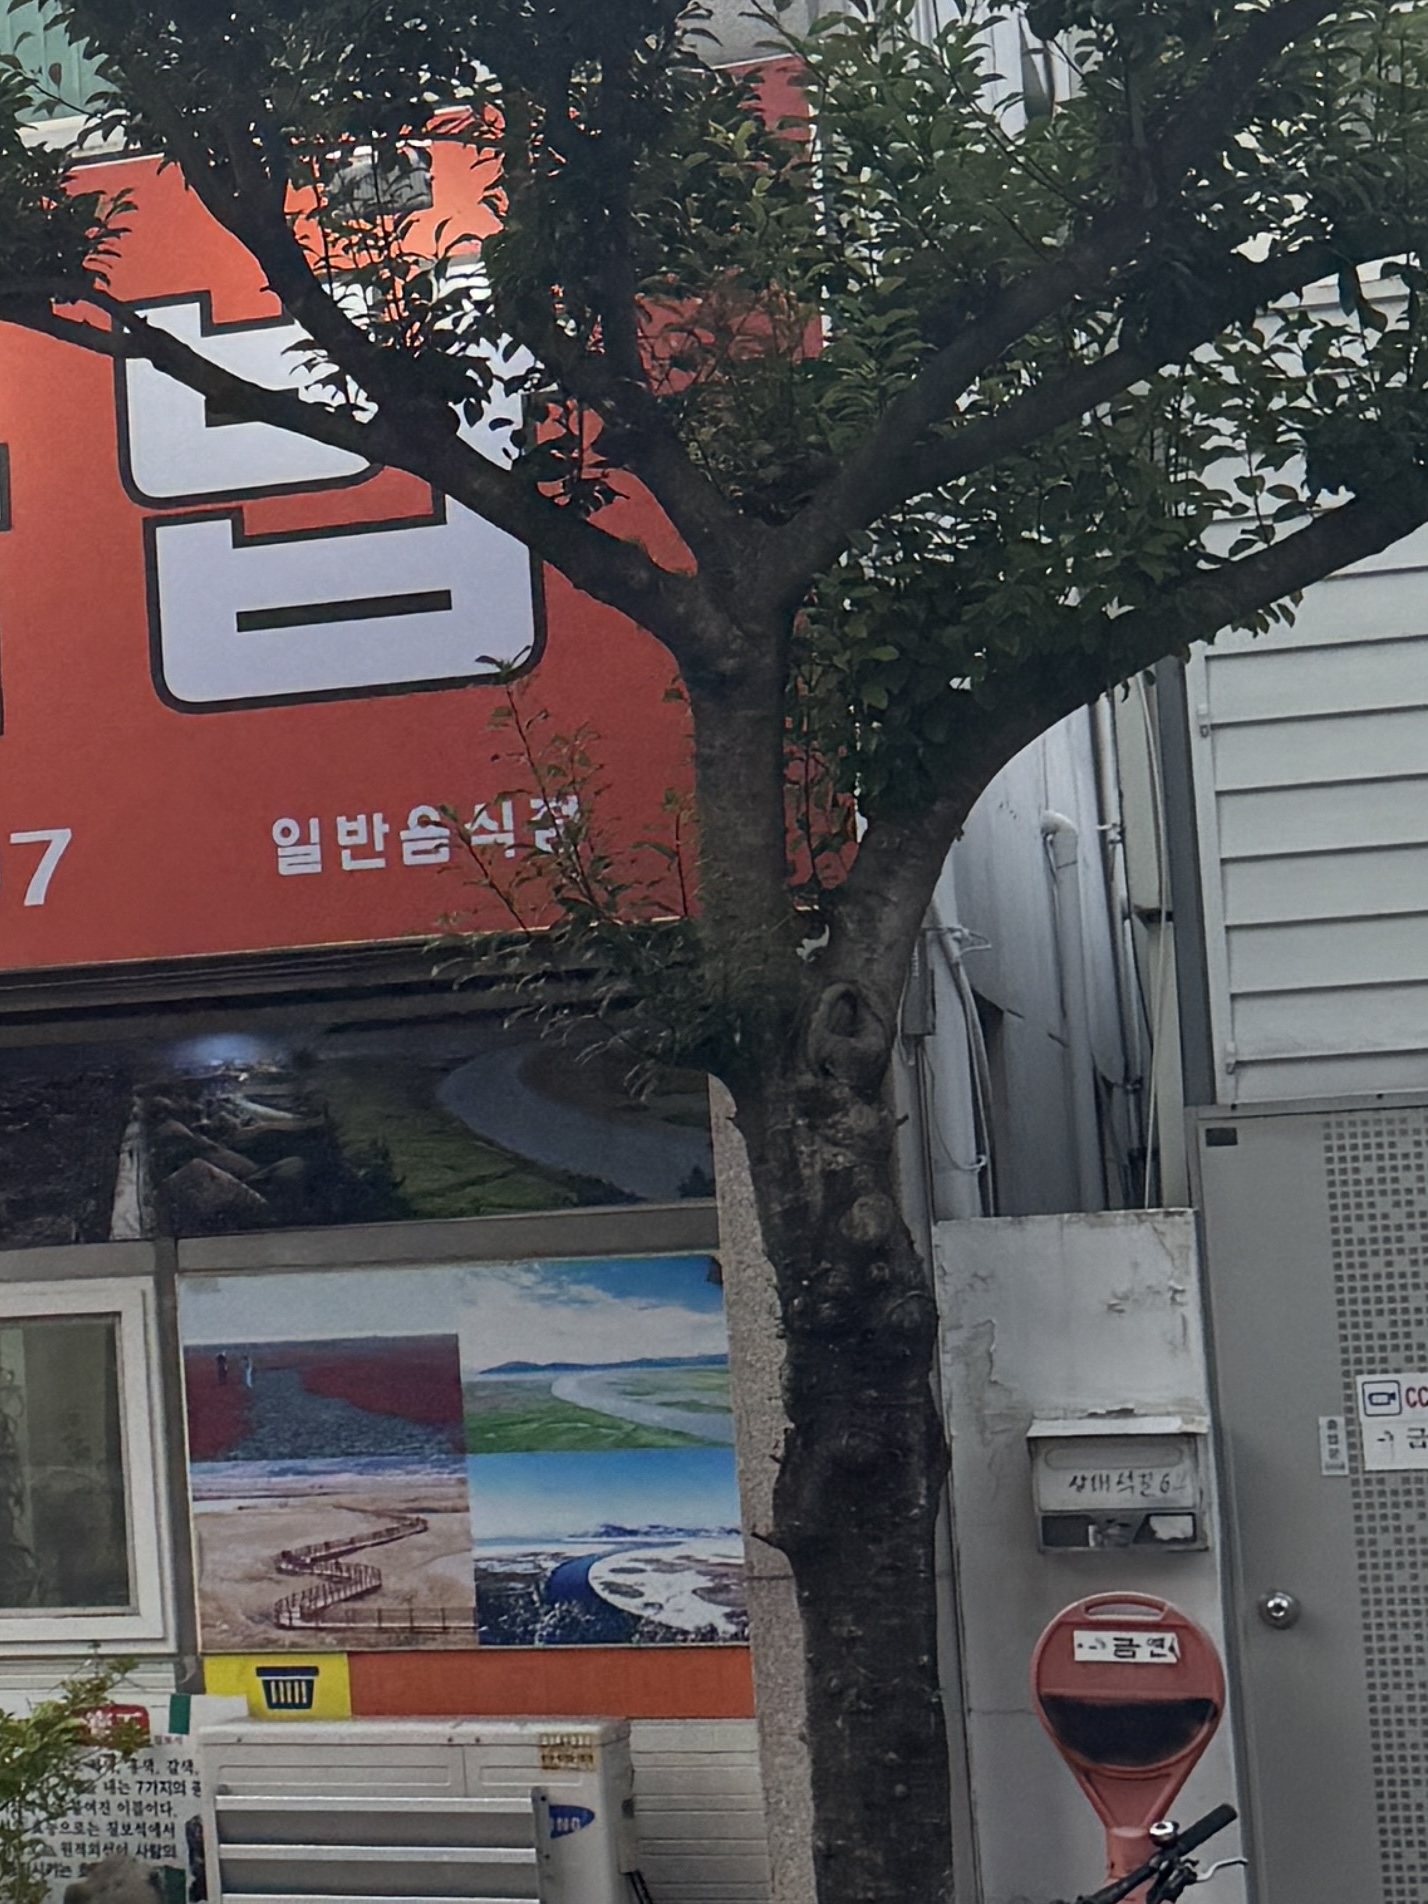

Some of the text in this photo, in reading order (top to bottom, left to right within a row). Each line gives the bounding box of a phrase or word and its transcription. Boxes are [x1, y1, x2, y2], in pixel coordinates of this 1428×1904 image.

[135, 1780, 187, 1796] 7가지의
[116, 1799, 178, 1817] 이름이다.
[135, 1844, 178, 1860] 사람의
